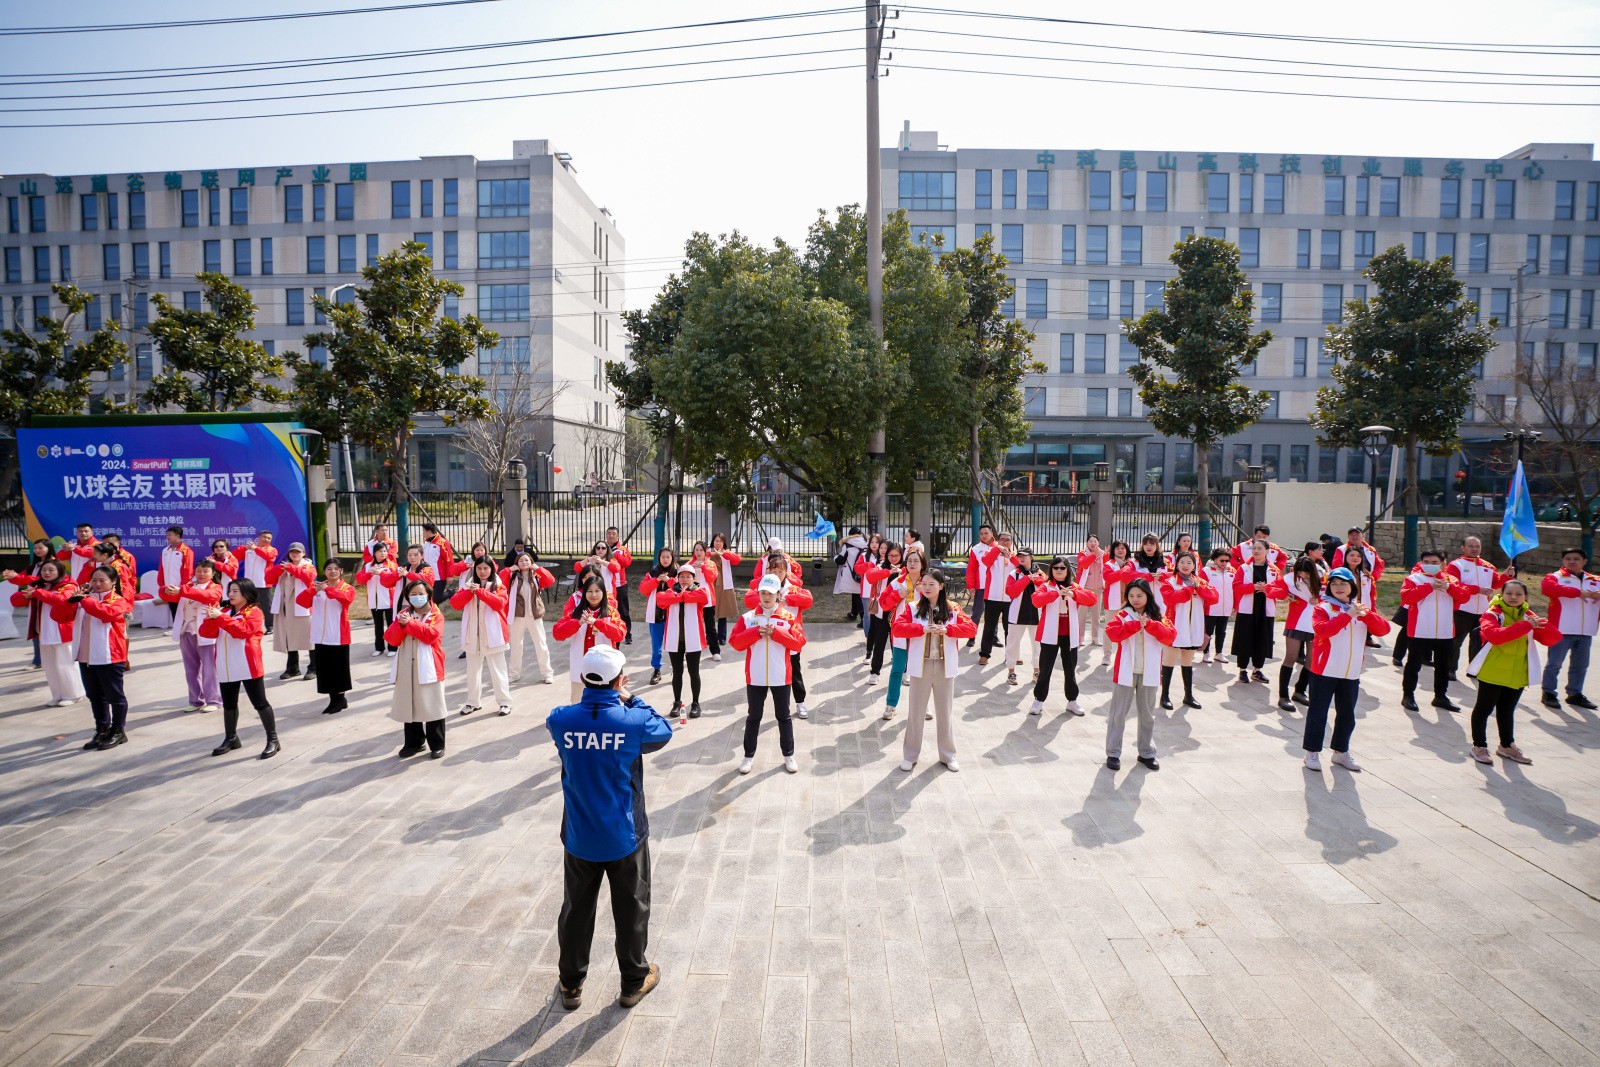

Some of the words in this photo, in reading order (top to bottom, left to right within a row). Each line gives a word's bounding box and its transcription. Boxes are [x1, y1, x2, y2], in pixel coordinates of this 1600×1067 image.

[1037, 150, 1544, 180] 中科昆山高科技创业服务中心
[133, 461, 168, 469] SmartPutt
[63, 474, 155, 499] 以球会友
[161, 472, 256, 499] 共展风采
[103, 500, 216, 511] 暨昆山市友好商会迷你高球交流赛
[139, 515, 184, 525] 联合主办单位
[563, 731, 626, 750] STAFF
